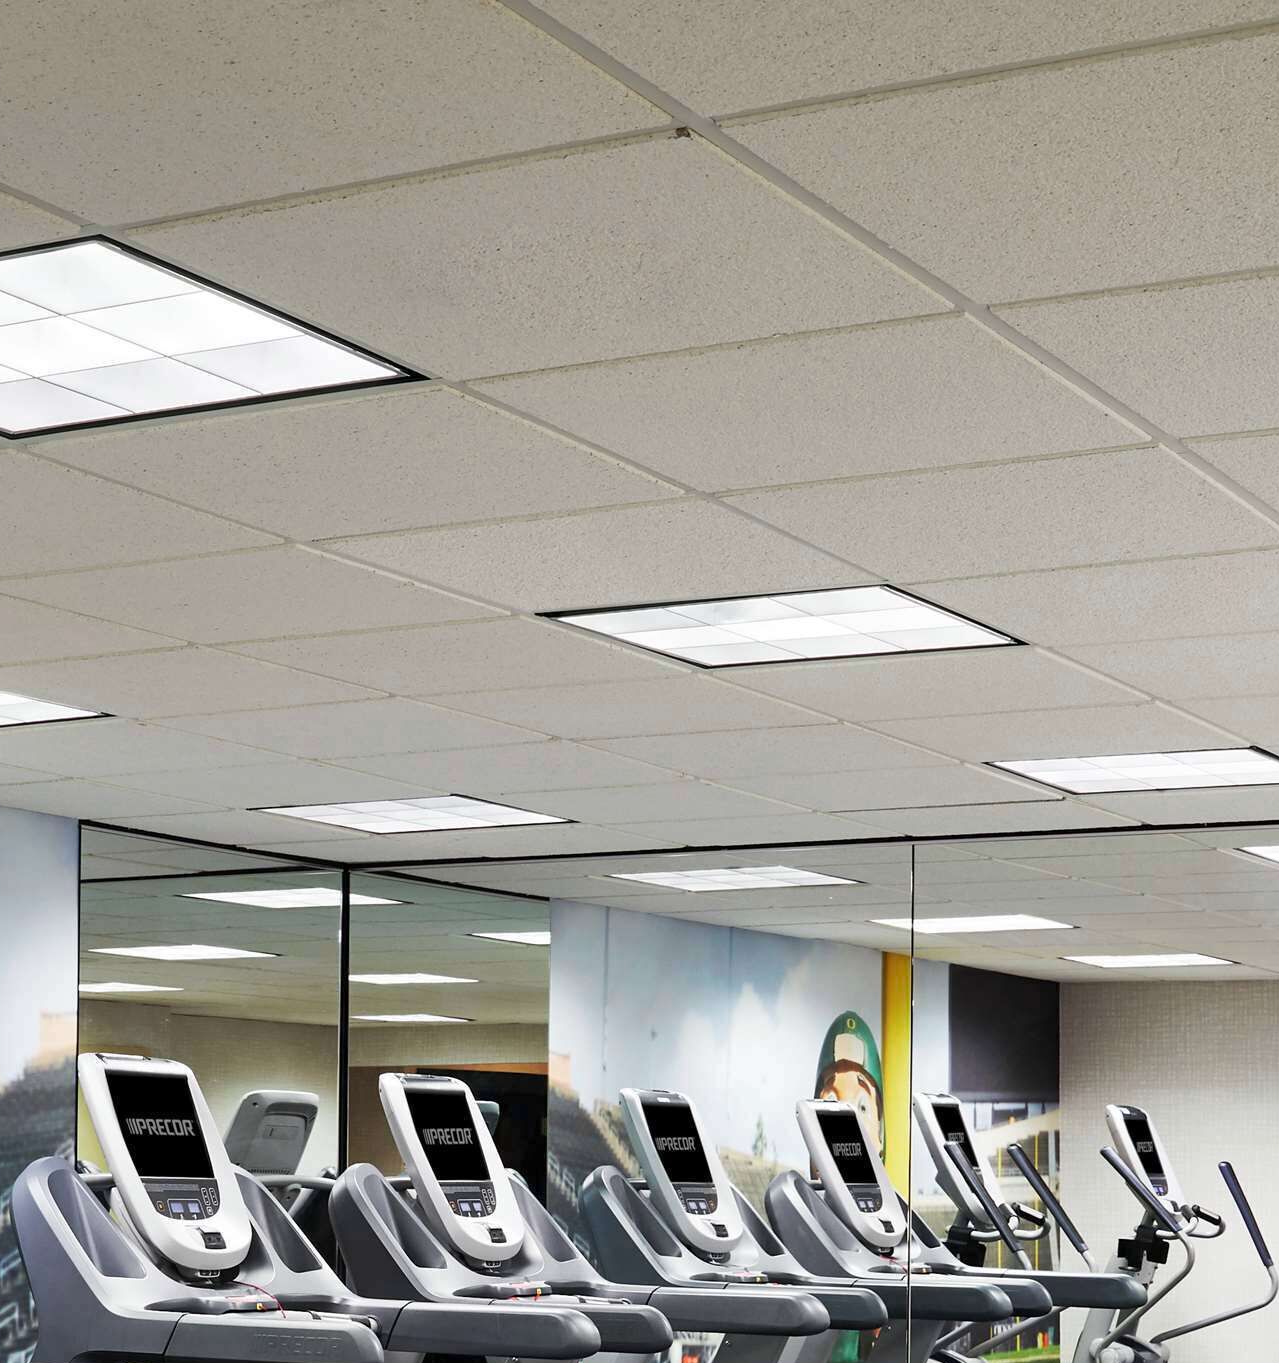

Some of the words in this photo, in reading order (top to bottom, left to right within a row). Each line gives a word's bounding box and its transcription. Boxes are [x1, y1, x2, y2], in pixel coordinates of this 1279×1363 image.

[126, 1118, 196, 1136] PRECOR
[422, 1127, 474, 1145] PRECOR
[655, 1136, 696, 1151] PRECOR
[832, 1142, 863, 1157] PRECOR
